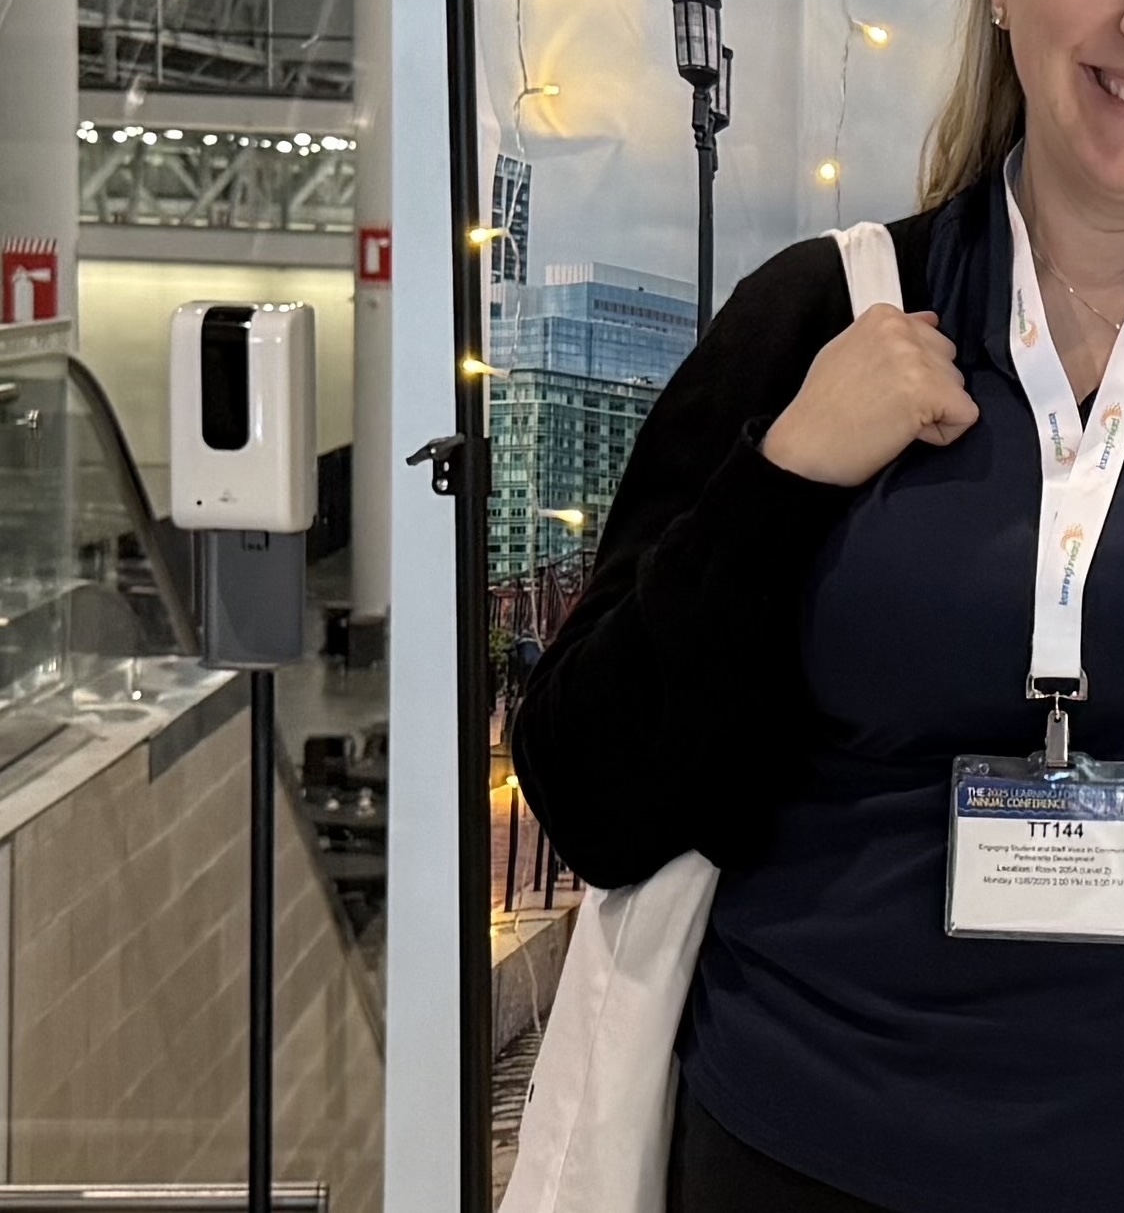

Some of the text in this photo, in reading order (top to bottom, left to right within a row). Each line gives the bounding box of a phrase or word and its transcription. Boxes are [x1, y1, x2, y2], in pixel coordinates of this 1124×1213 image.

[967, 787, 985, 798] THE
[966, 797, 1067, 810] ANNUAL CONFERENCE
[1028, 821, 1084, 839] TT144
